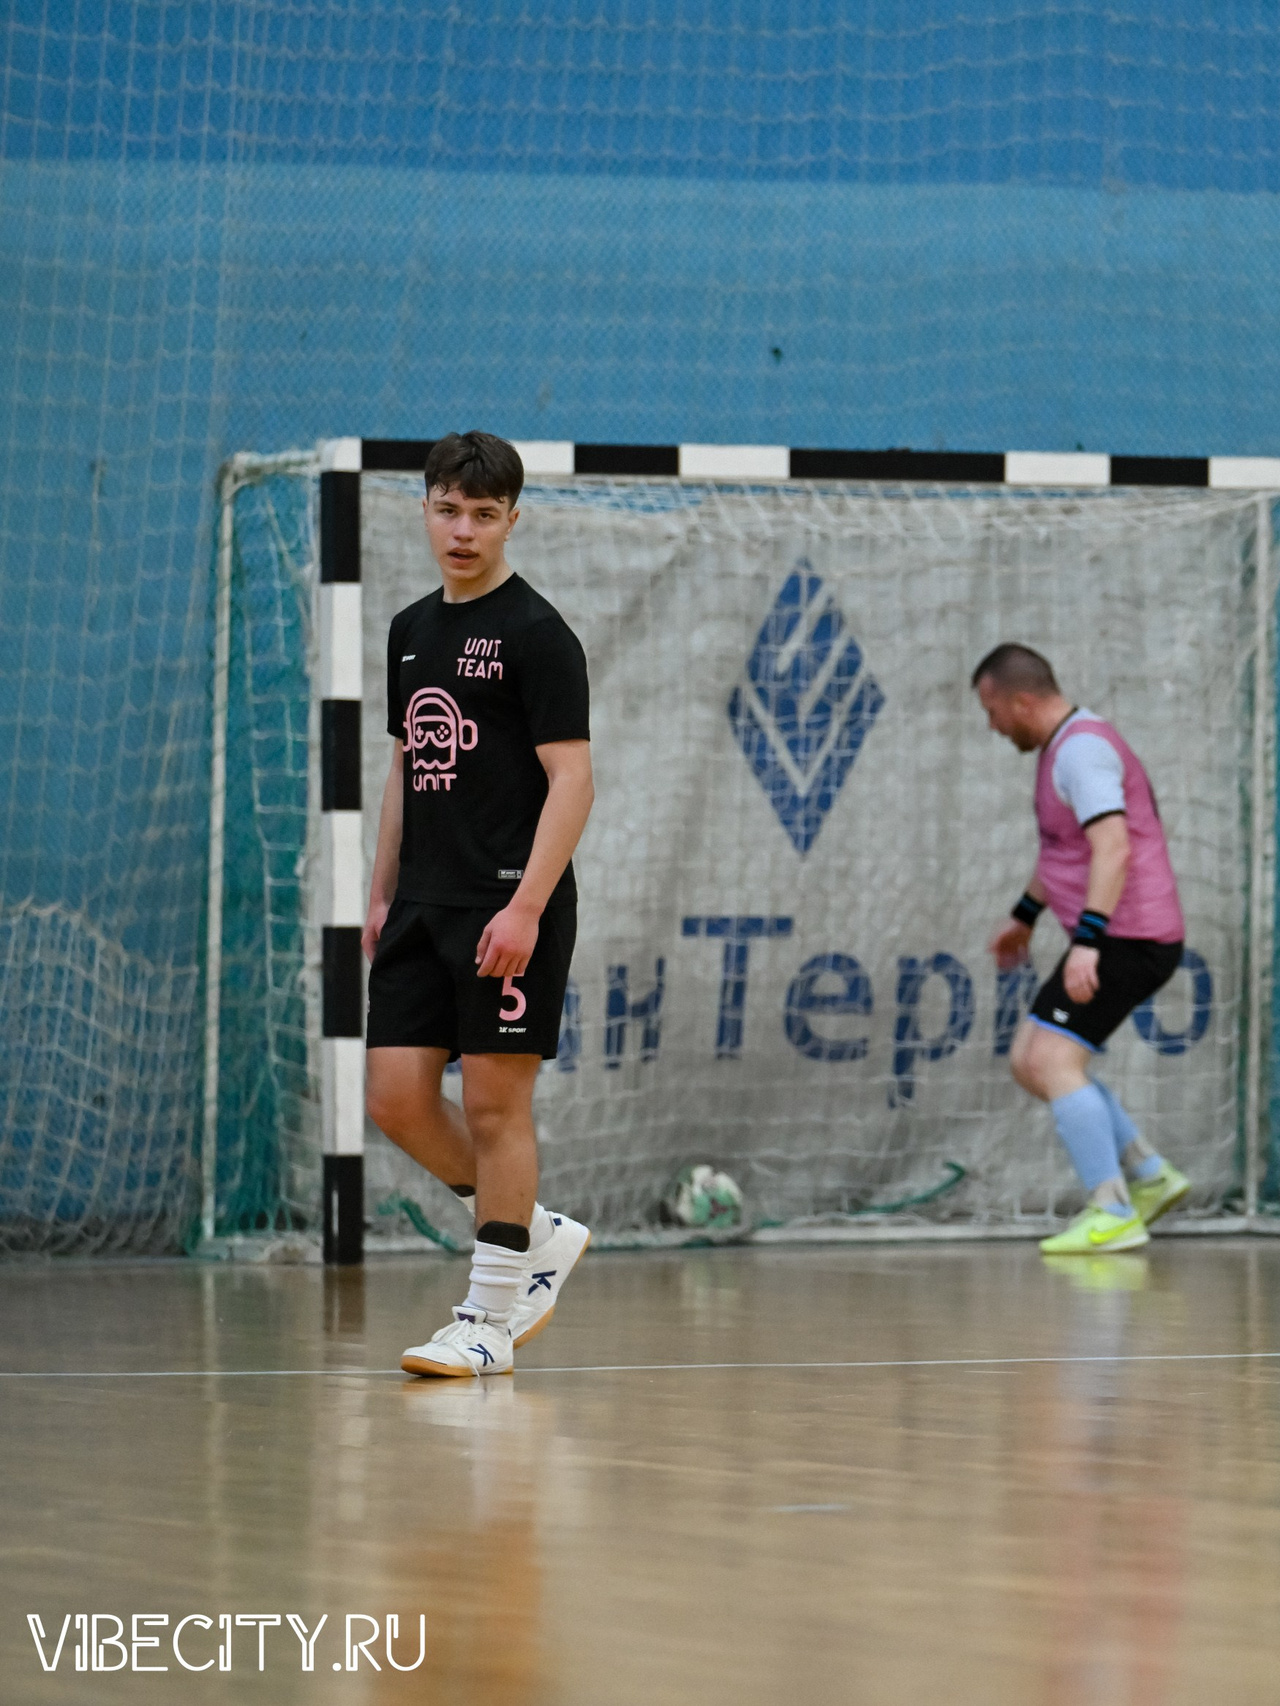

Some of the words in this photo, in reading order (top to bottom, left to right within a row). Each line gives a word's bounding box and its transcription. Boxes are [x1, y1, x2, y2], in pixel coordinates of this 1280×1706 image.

[464, 637, 502, 658] UNIT
[457, 658, 504, 680] TEAM
[413, 773, 457, 792] UNIT
[499, 973, 527, 1022] 5
